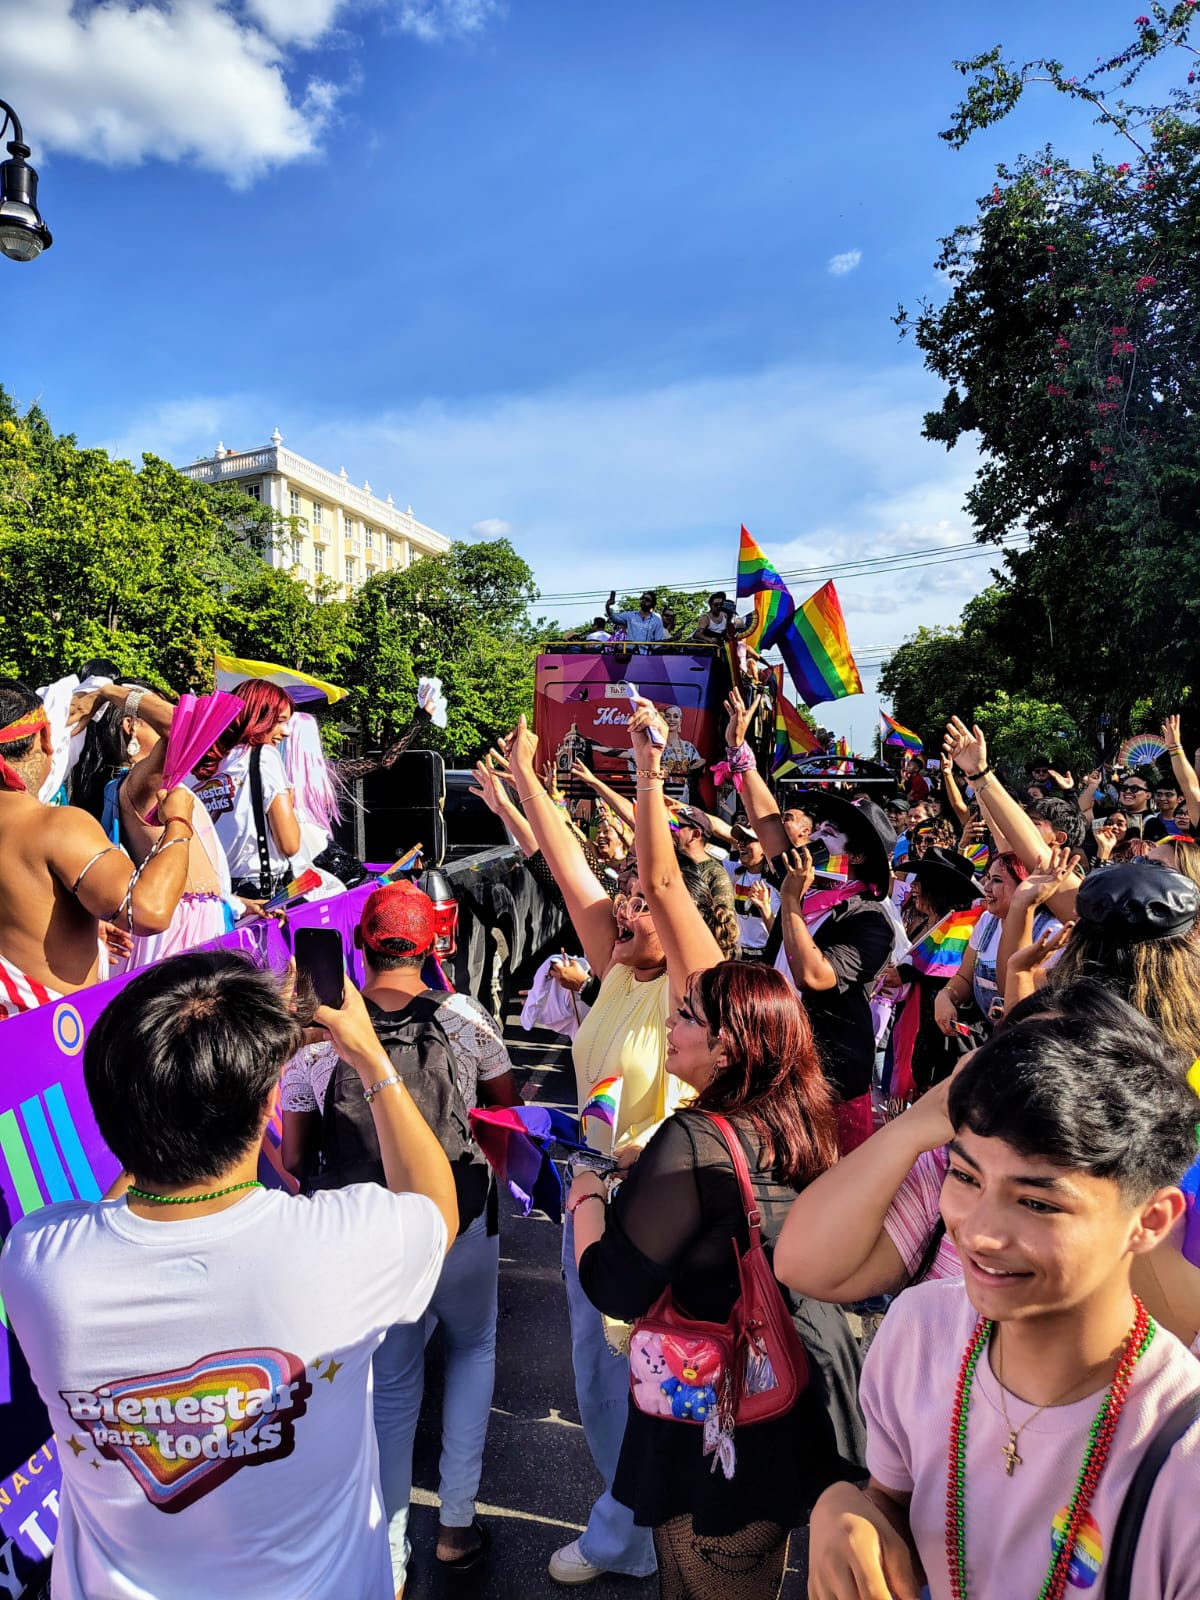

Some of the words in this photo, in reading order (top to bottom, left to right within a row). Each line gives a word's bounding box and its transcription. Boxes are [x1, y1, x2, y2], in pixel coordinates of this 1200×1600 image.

[593, 707, 630, 726] Méri
[196, 784, 231, 800] nestar
[205, 797, 230, 811] odxs
[62, 1382, 300, 1425] Bienestar
[94, 1428, 151, 1447] para
[156, 1421, 283, 1460] todxs
[0, 1433, 58, 1514] NACI
